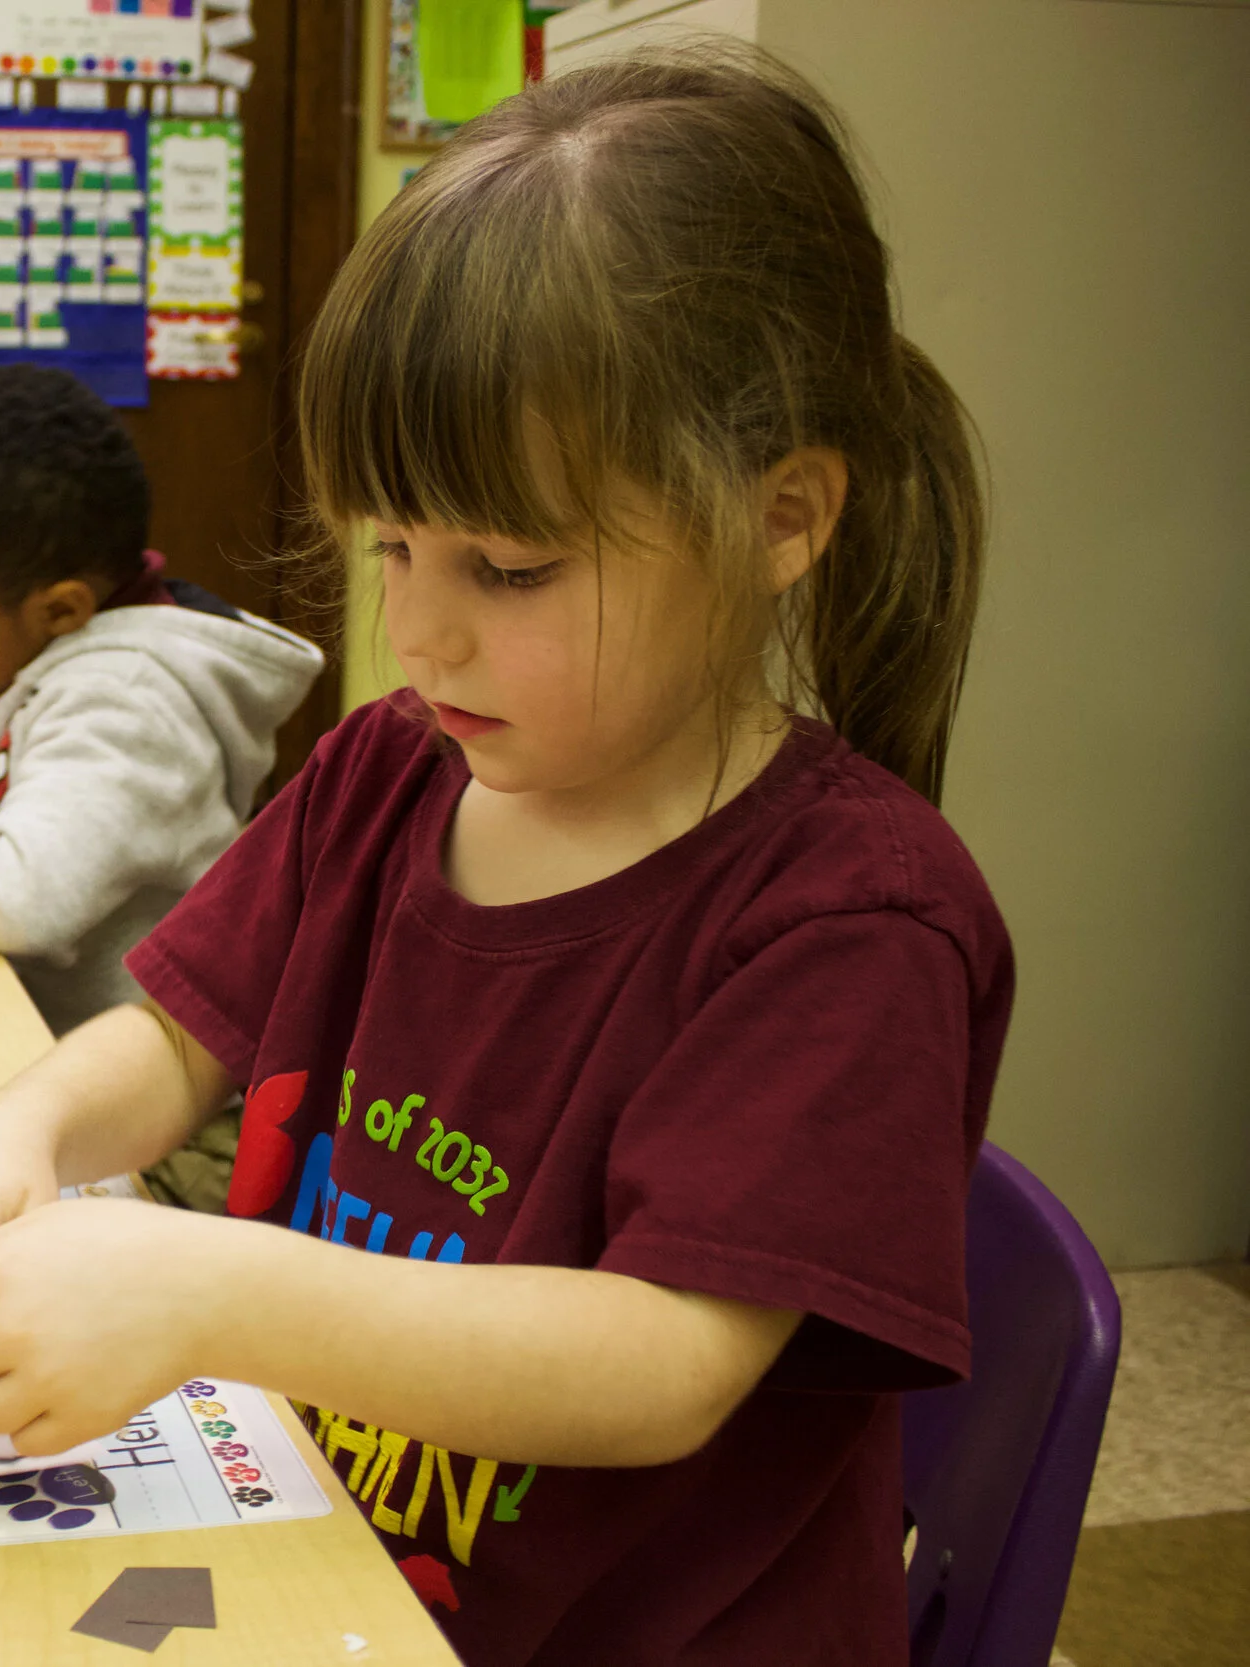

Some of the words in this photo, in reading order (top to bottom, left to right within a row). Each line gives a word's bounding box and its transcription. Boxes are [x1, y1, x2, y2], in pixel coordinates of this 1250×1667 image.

[365, 1093, 426, 1152] of
[415, 1117, 510, 1217] 2032
[53, 1469, 99, 1500] Left
